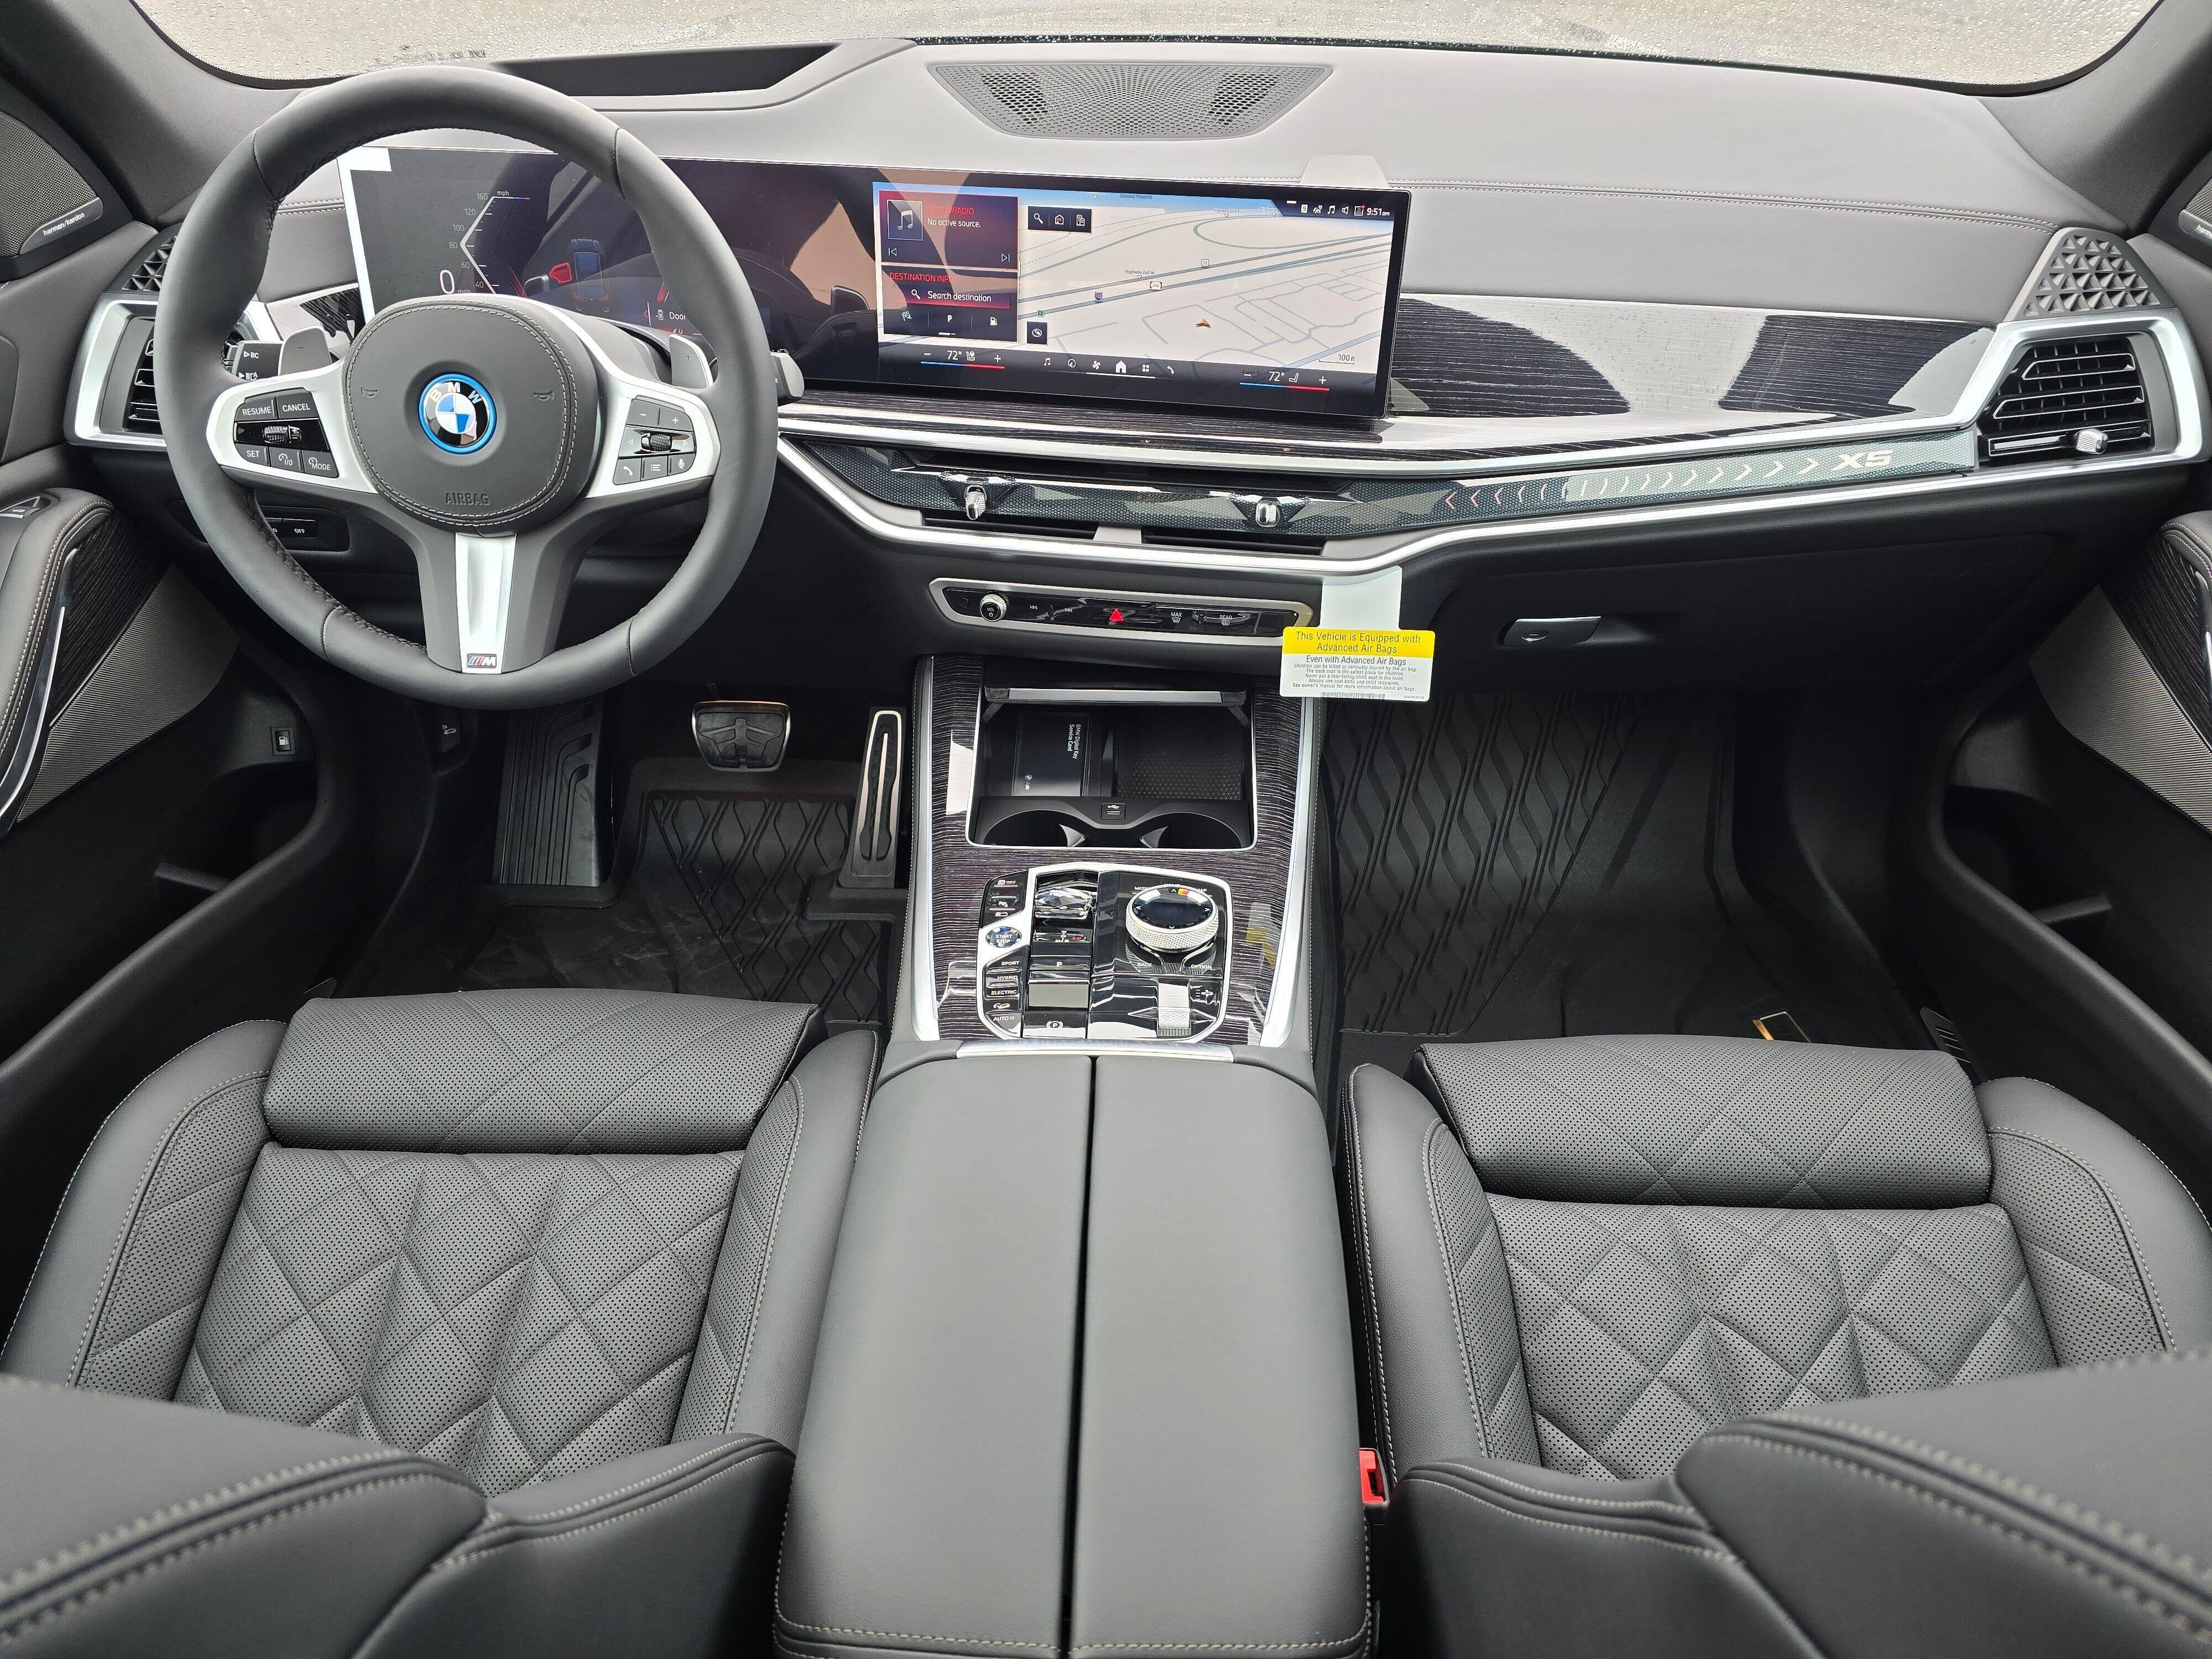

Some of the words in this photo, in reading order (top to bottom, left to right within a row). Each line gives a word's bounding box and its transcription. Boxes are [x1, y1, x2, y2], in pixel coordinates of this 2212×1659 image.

[43, 212, 85, 236] harman/kardon
[440, 269, 455, 294] 0
[889, 273, 936, 282] DESTINATION
[927, 291, 951, 300] Search
[953, 292, 992, 302] destination
[429, 382, 482, 404] BMW
[242, 406, 272, 416] RESUME
[282, 403, 311, 412] CANCEL
[1832, 449, 1893, 471] X5
[445, 492, 491, 505] AIRBAG
[1296, 632, 1313, 640] This
[1317, 632, 1346, 641] Vehicle
[1360, 633, 1400, 644] Equipped
[1403, 635, 1421, 644] with
[1317, 643, 1358, 652] Advanced
[1361, 644, 1373, 653] Air
[1376, 645, 1397, 655] Bags
[1341, 656, 1375, 665] Advanced
[1389, 658, 1406, 667] Bags
